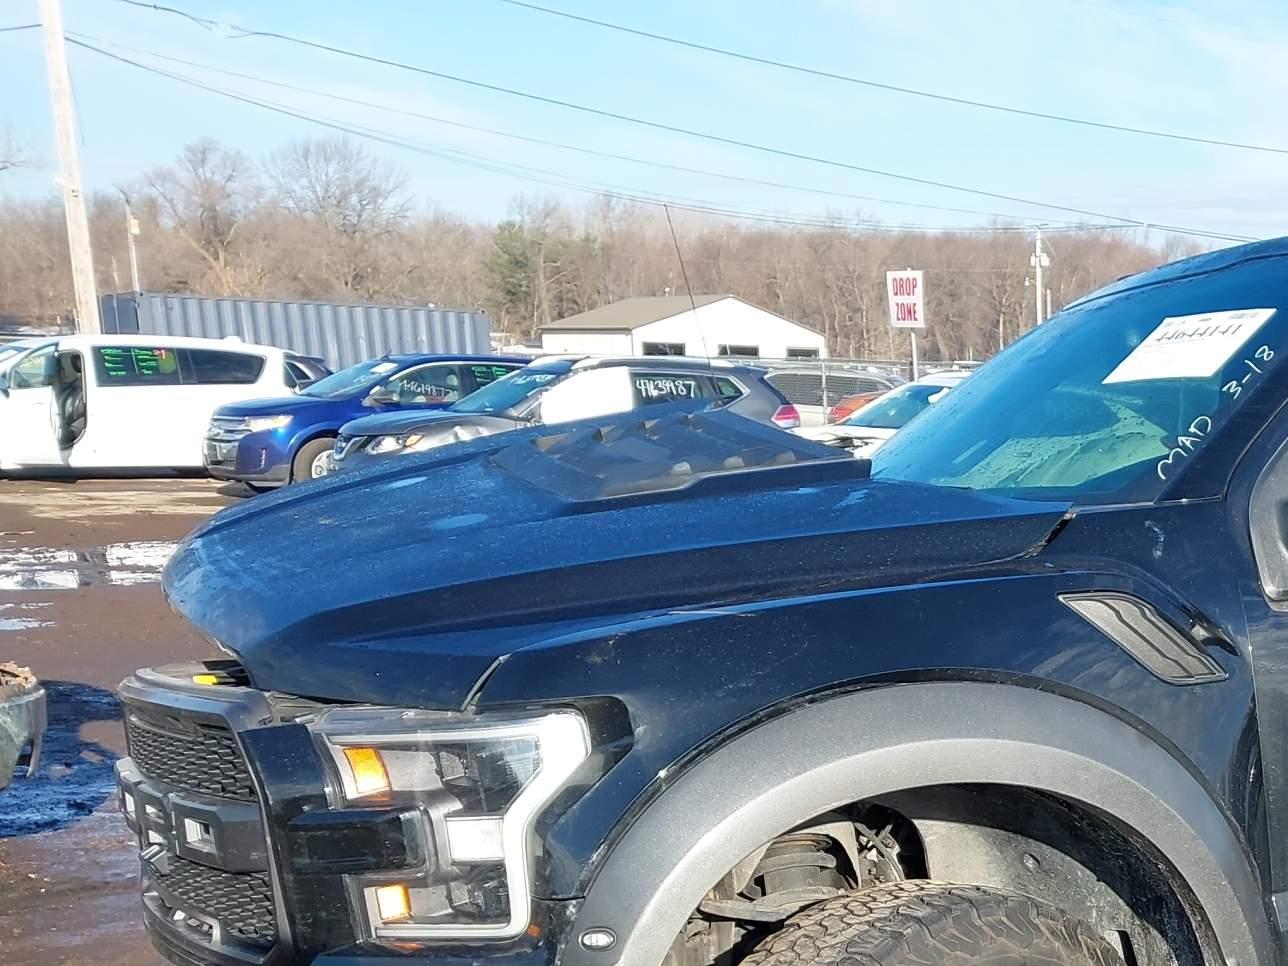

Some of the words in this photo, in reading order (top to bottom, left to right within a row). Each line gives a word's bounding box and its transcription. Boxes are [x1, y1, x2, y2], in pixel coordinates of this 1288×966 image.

[892, 277, 918, 297] DROP
[895, 302, 918, 322] ZONE
[1221, 345, 1275, 400] 3-18
